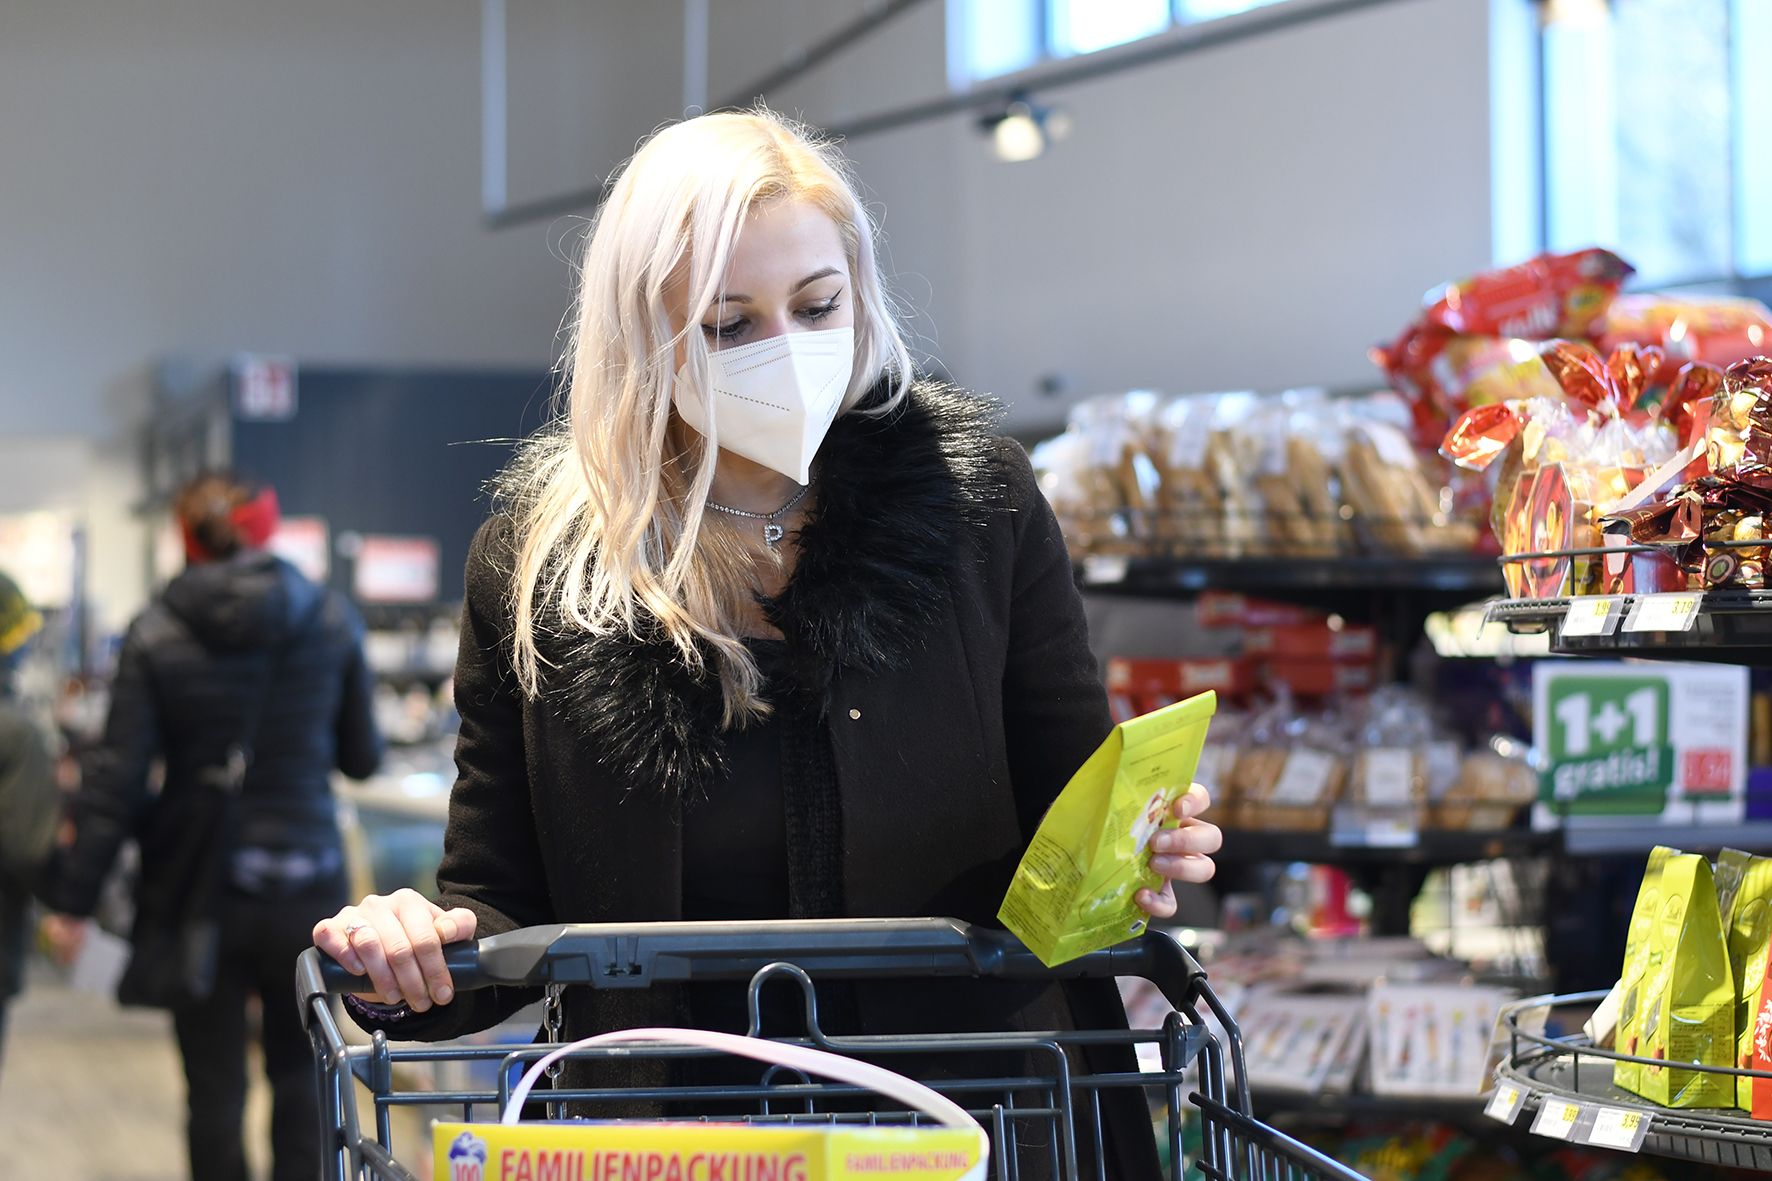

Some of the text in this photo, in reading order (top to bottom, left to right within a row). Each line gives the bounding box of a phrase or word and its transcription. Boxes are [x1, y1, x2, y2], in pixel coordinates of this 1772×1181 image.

[1555, 687, 1658, 755] 1+1
[1554, 749, 1659, 800] gratis!
[501, 1148, 807, 1181] FAMILIENPACKUNG
